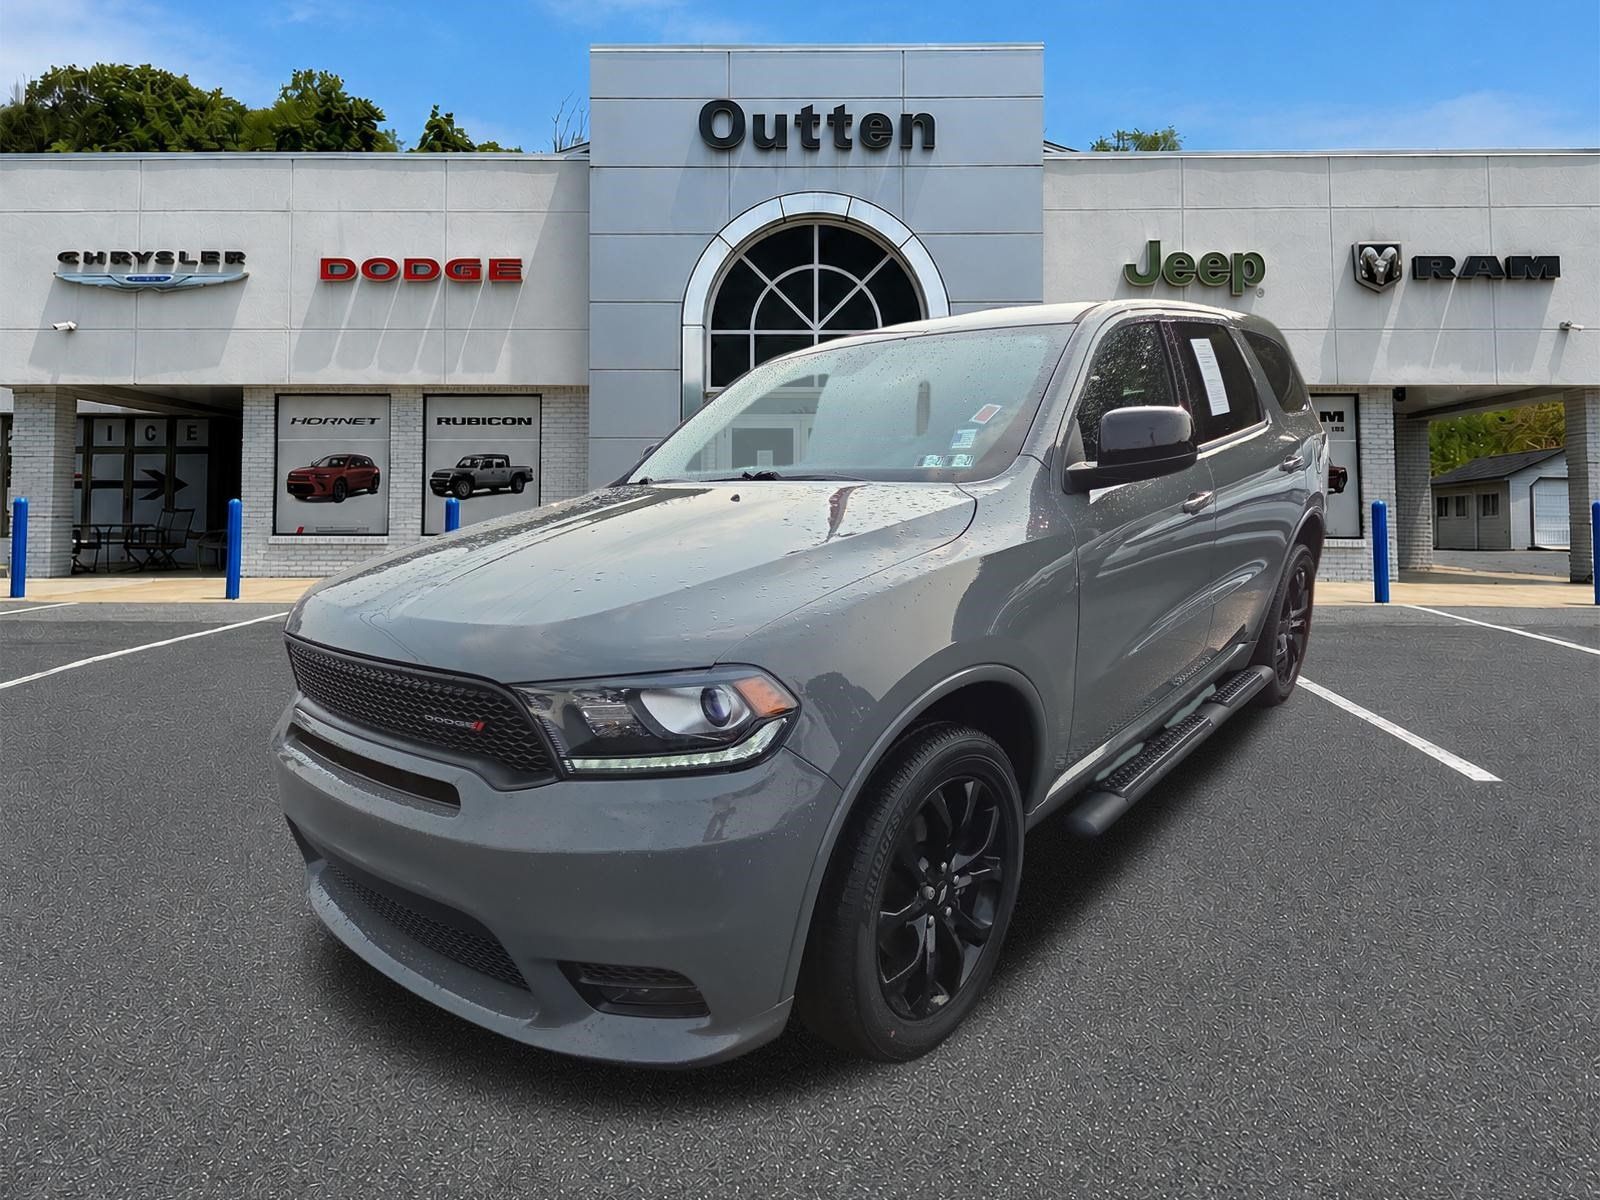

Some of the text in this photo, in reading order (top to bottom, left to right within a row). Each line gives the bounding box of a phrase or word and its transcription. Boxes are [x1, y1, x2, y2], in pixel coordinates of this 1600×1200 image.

[699, 99, 936, 149] Outten
[57, 250, 247, 266] CHRYSLER
[1124, 240, 1266, 296] Jeep
[1412, 256, 1561, 280] RAM
[320, 257, 523, 283] DODGE
[290, 416, 381, 426] HORNET
[436, 416, 533, 426] RUBICON
[424, 714, 477, 730] DODGE
